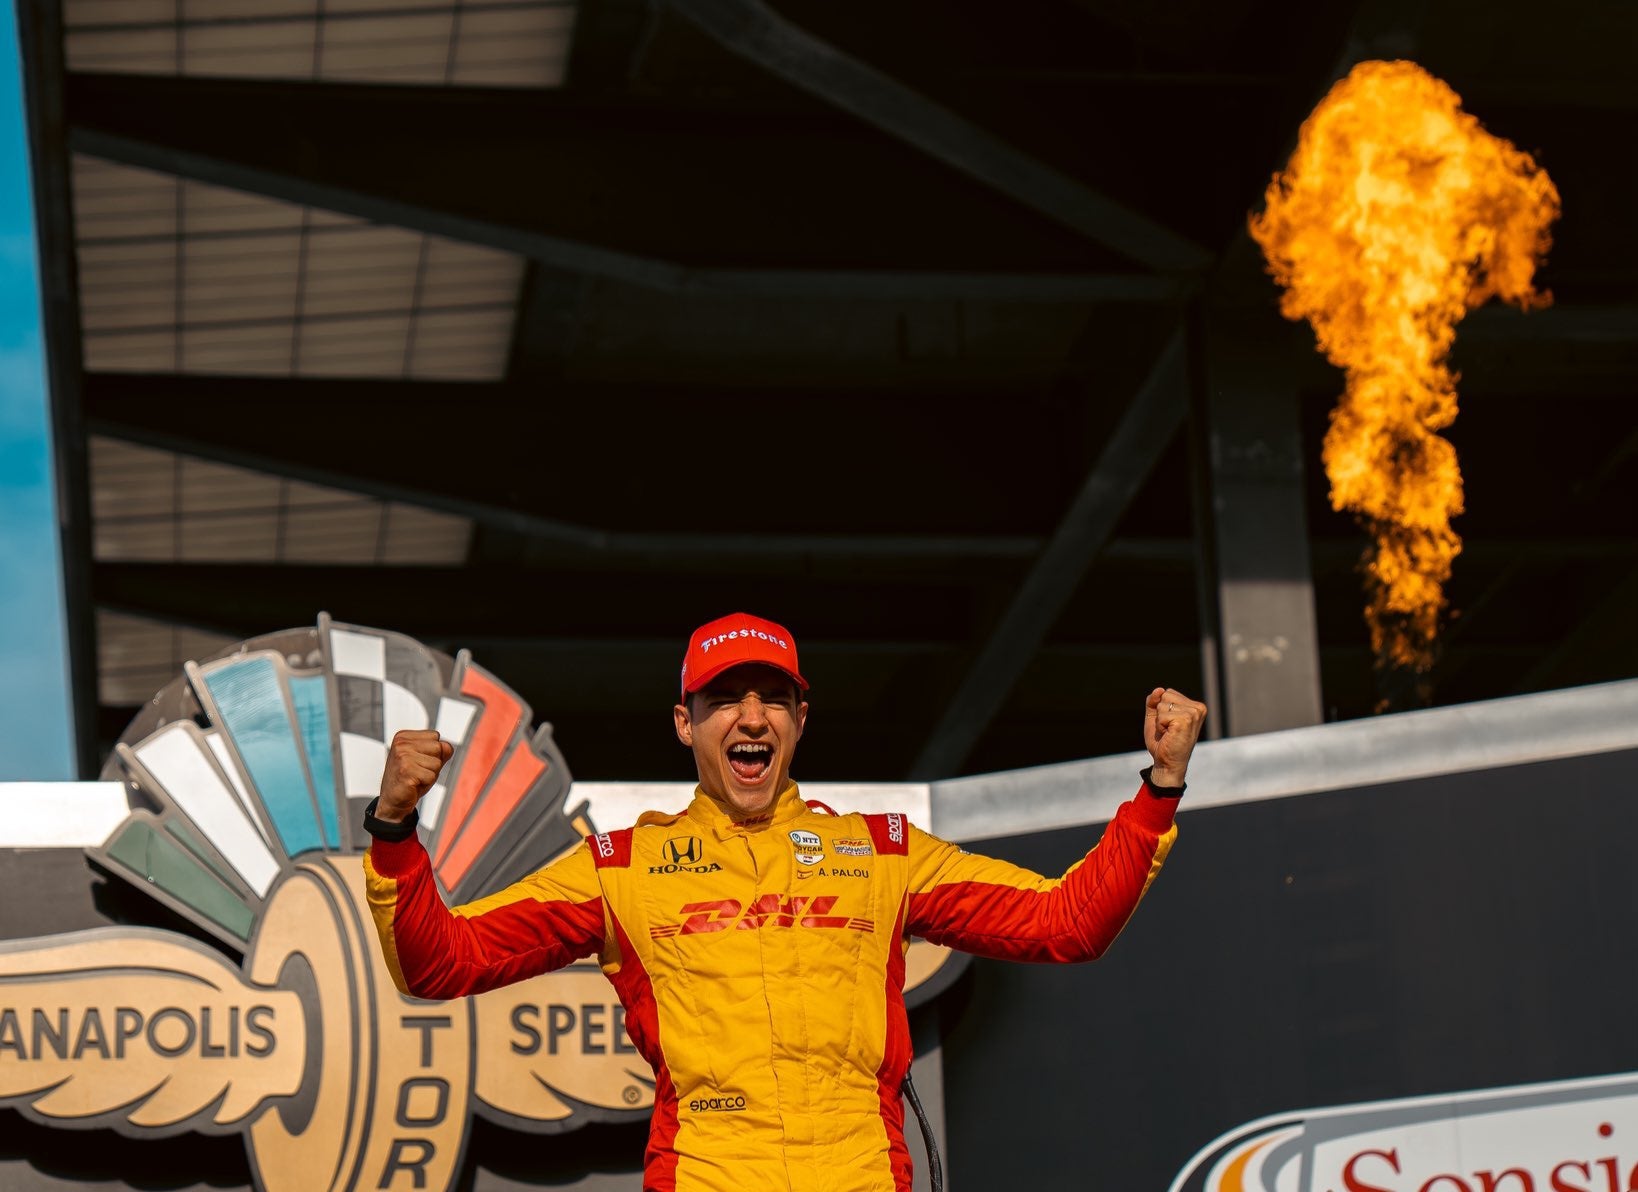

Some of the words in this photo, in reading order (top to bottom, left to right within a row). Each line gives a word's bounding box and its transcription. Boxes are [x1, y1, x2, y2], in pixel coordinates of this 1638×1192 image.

[701, 628, 788, 653] Firestone
[648, 862, 724, 875] HONDA
[818, 867, 829, 877] A.
[832, 868, 870, 879] PALOU
[679, 893, 850, 936] DHL
[689, 1096, 746, 1112] sparco
